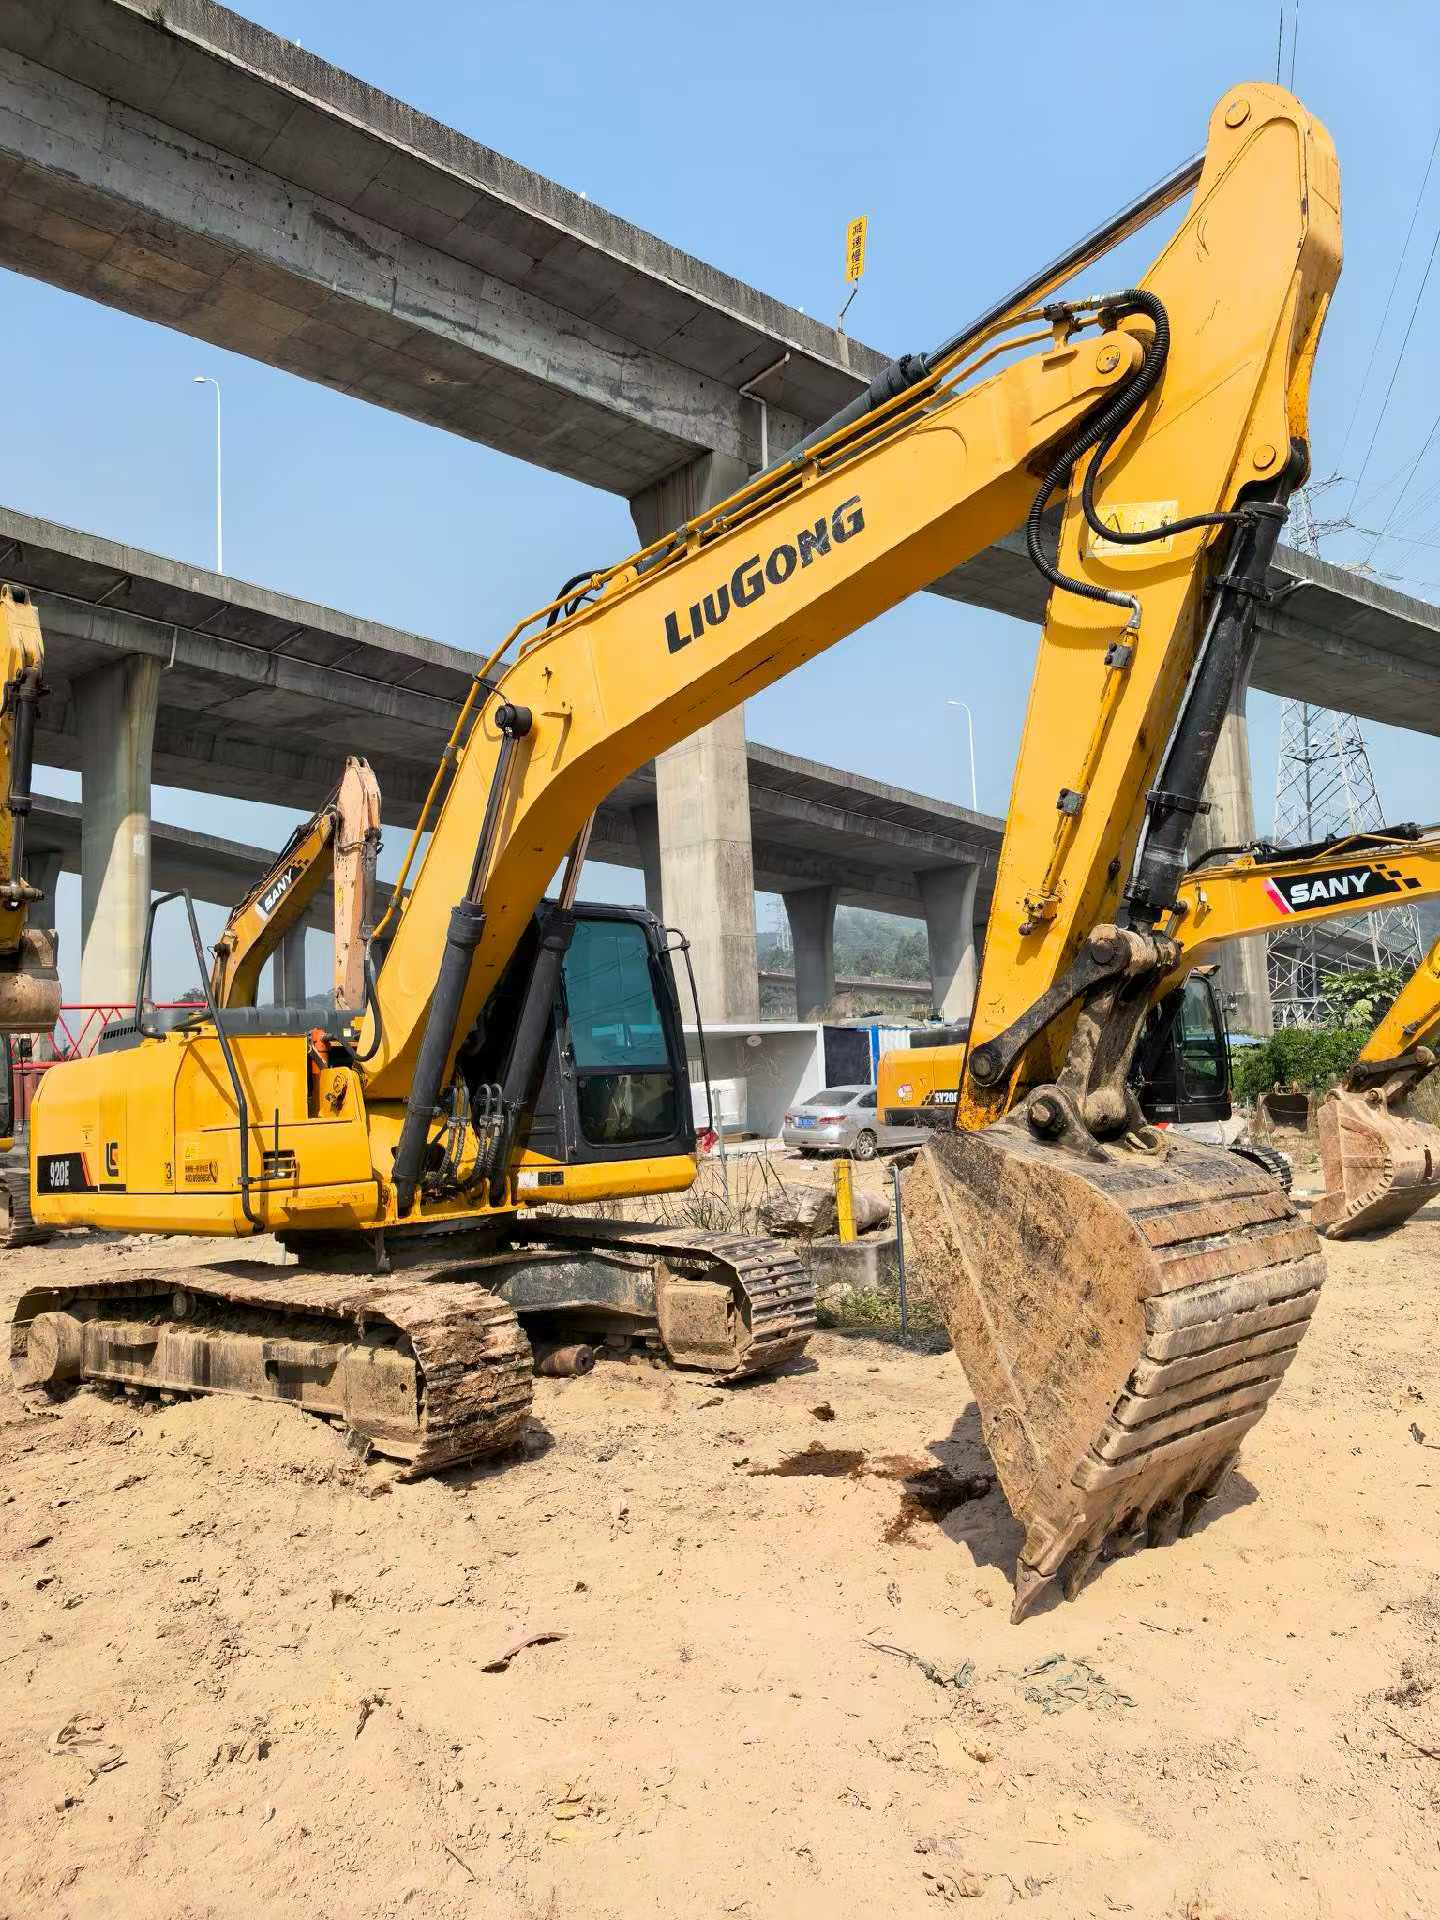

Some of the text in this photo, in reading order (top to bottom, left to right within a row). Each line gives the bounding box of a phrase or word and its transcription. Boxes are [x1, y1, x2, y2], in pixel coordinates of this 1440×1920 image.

[264, 868, 292, 911] SANY
[1290, 872, 1370, 904] SANY
[50, 1161, 70, 1186] 920E
